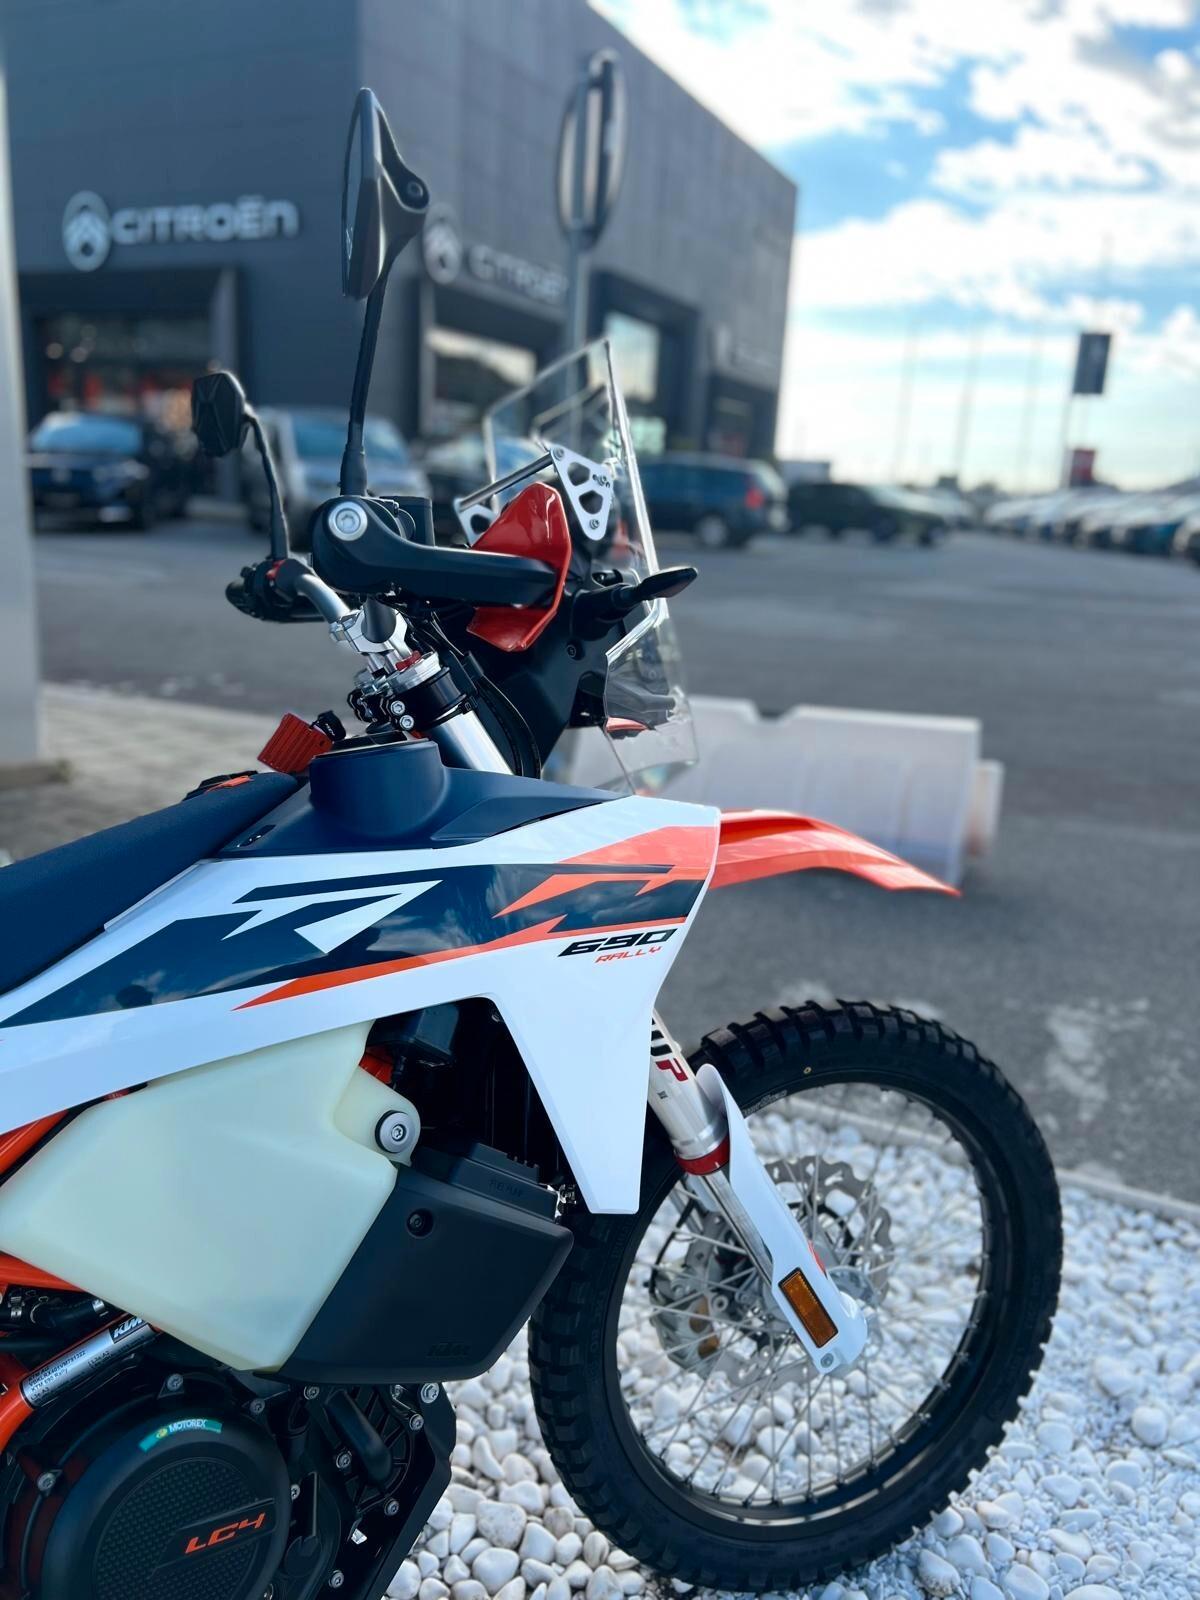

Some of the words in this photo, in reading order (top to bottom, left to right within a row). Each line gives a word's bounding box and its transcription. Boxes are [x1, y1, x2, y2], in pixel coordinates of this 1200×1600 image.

[558, 928, 678, 957] 690
[595, 945, 662, 963] RALLY
[113, 1316, 144, 1338] KTM
[168, 1418, 207, 1433] MOTOREX
[185, 1512, 266, 1554] LC4
